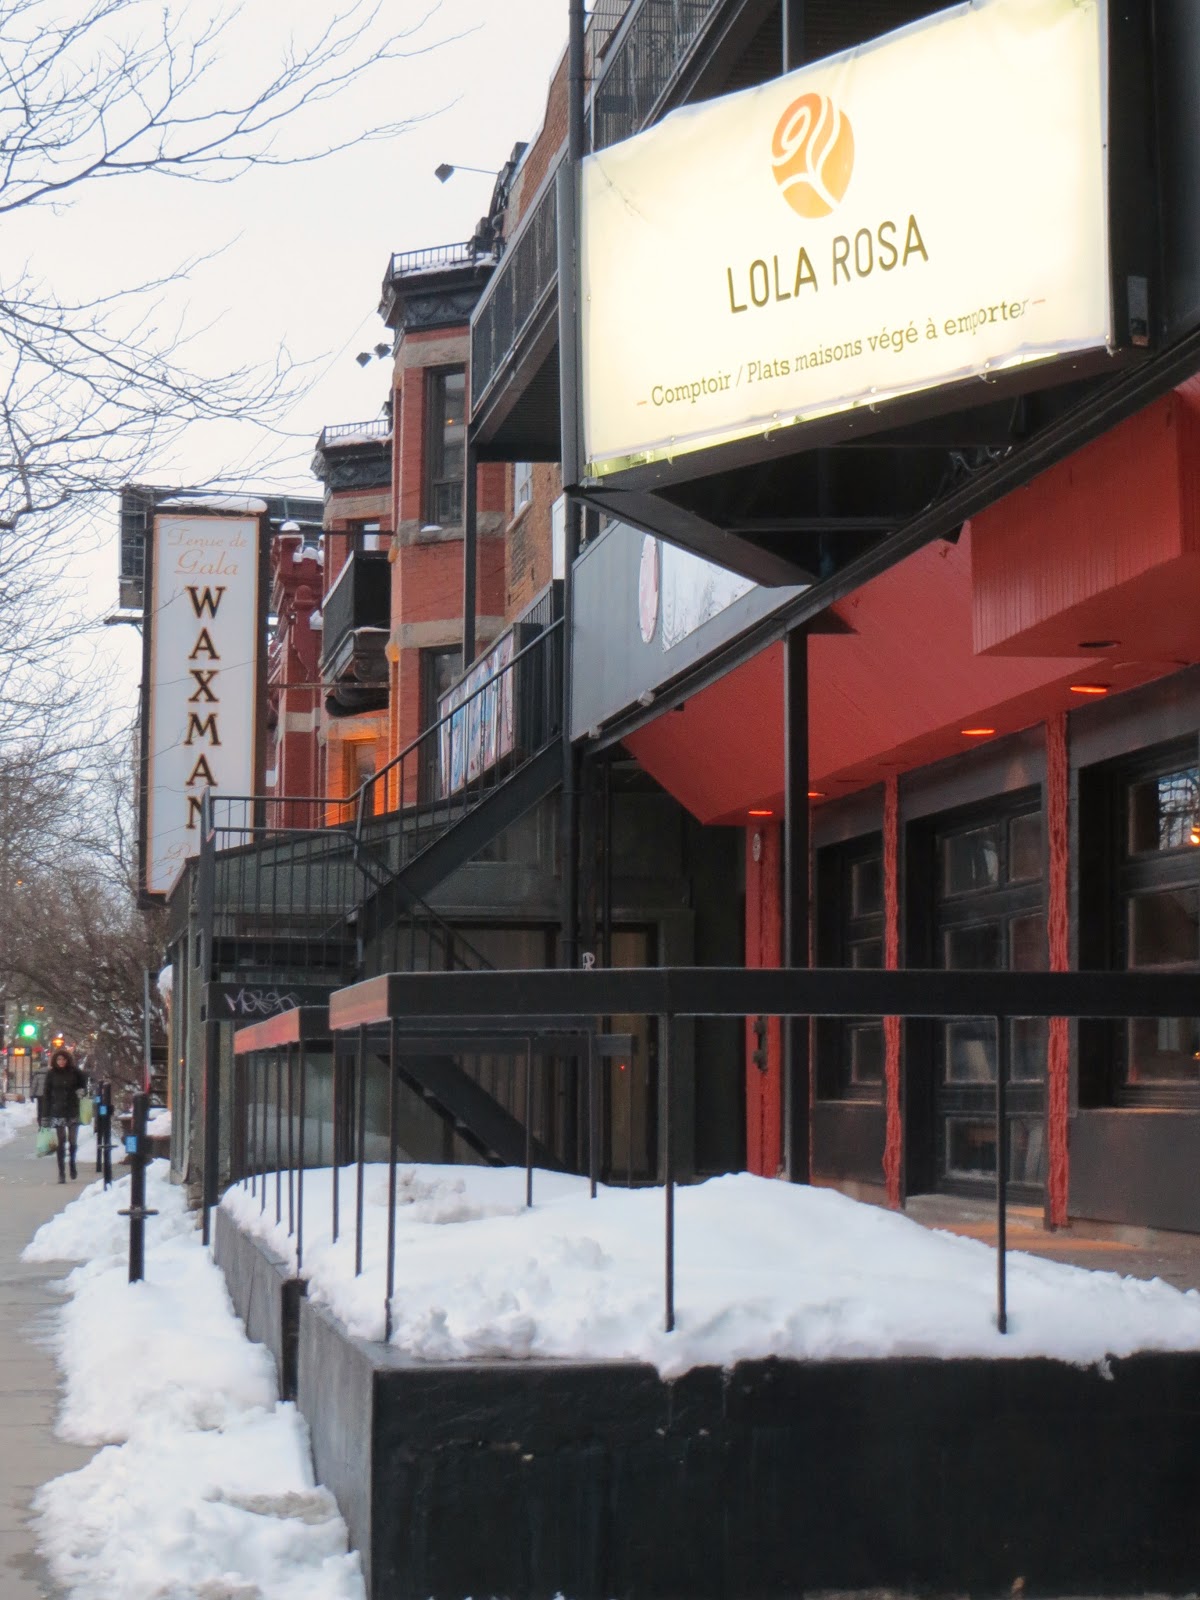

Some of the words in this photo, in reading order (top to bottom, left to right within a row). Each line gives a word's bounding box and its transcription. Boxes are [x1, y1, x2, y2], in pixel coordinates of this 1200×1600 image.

[727, 246, 819, 313] LOLA
[832, 214, 929, 286] ROSA
[651, 370, 731, 406] Comptoir
[747, 358, 791, 384] Plats
[794, 338, 863, 373] maisons
[867, 321, 919, 352] végé
[926, 318, 938, 340] à
[944, 299, 1030, 336] emporter
[167, 528, 224, 548] Tenue
[228, 529, 248, 548] de
[174, 549, 239, 576] Gala
